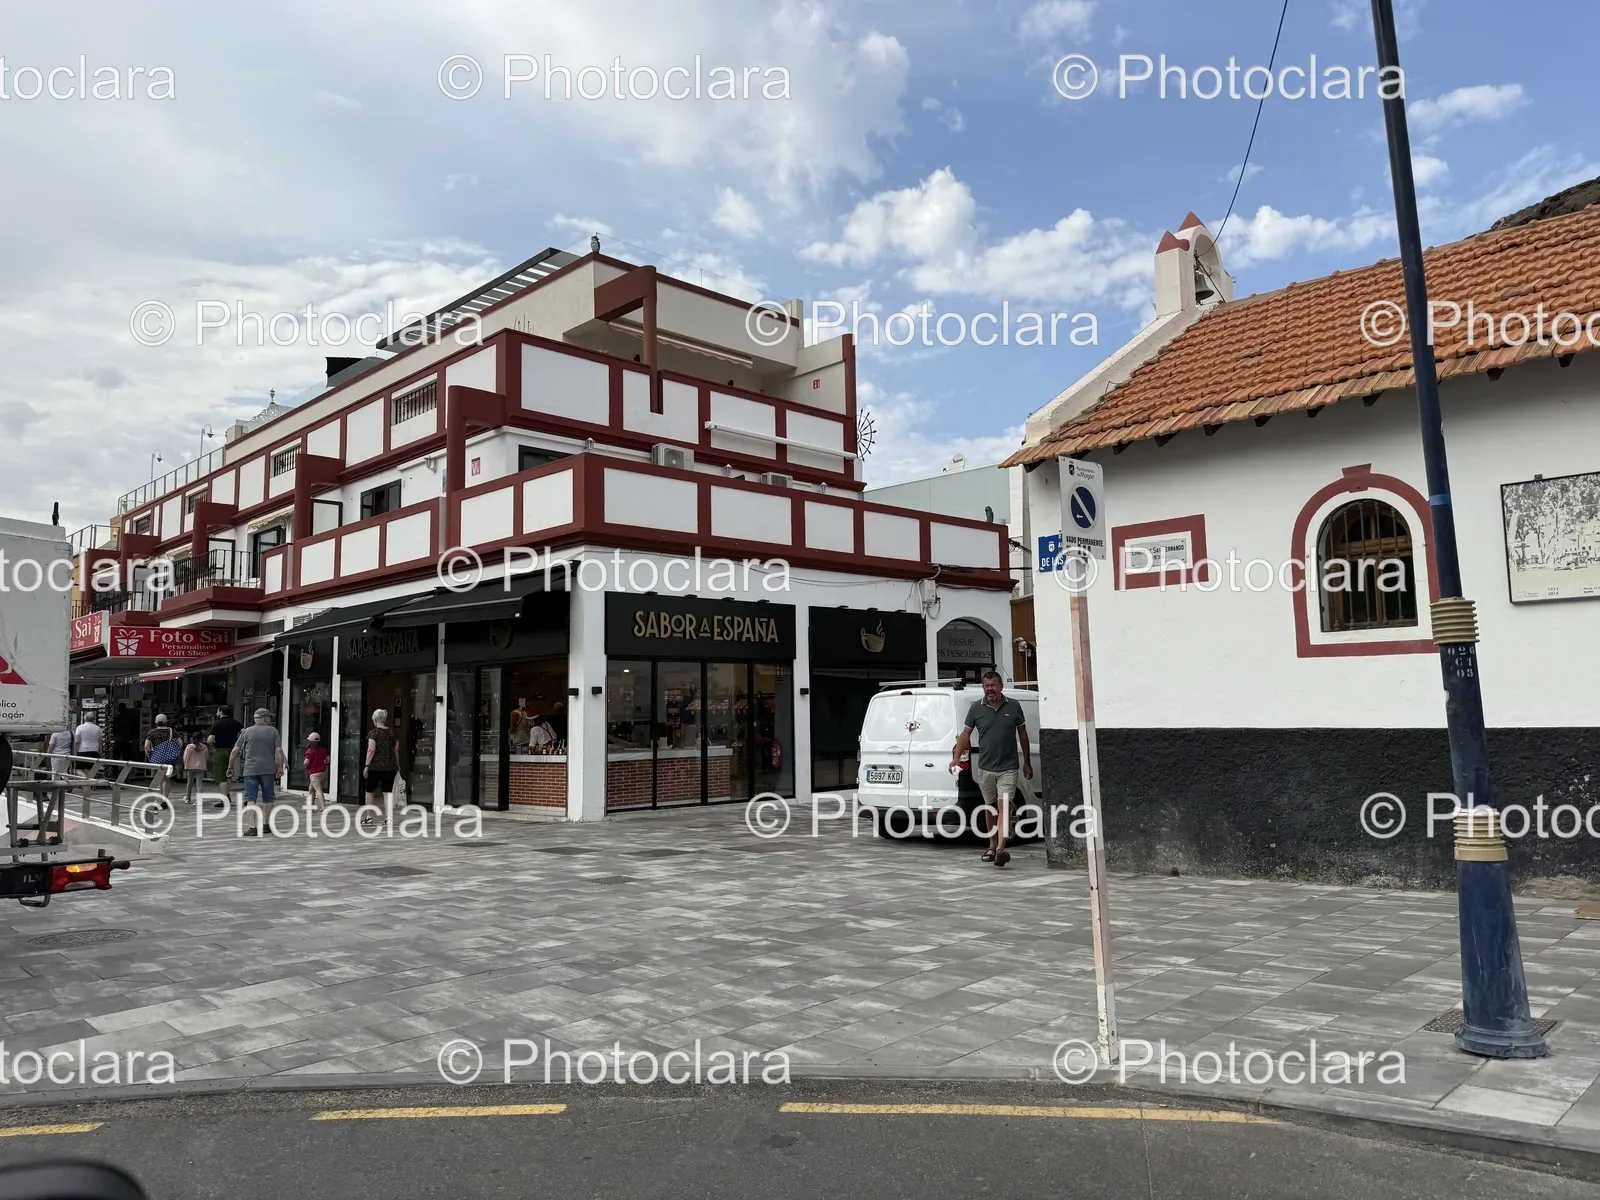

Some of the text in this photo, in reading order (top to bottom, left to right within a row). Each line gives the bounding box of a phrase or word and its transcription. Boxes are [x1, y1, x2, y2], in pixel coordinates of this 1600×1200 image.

[1077, 537, 1103, 548] PERMANENTE
[1162, 544, 1184, 553] ERNANDO
[1041, 557, 1050, 567] DE
[75, 617, 91, 639] Sai
[633, 610, 779, 643] SABOR A ESPAÑA
[150, 629, 229, 643] Foto Sai
[948, 637, 975, 647] PASAJE
[937, 648, 992, 660] OS PESCADORES
[0, 699, 17, 708] lico
[0, 711, 25, 720] ogán
